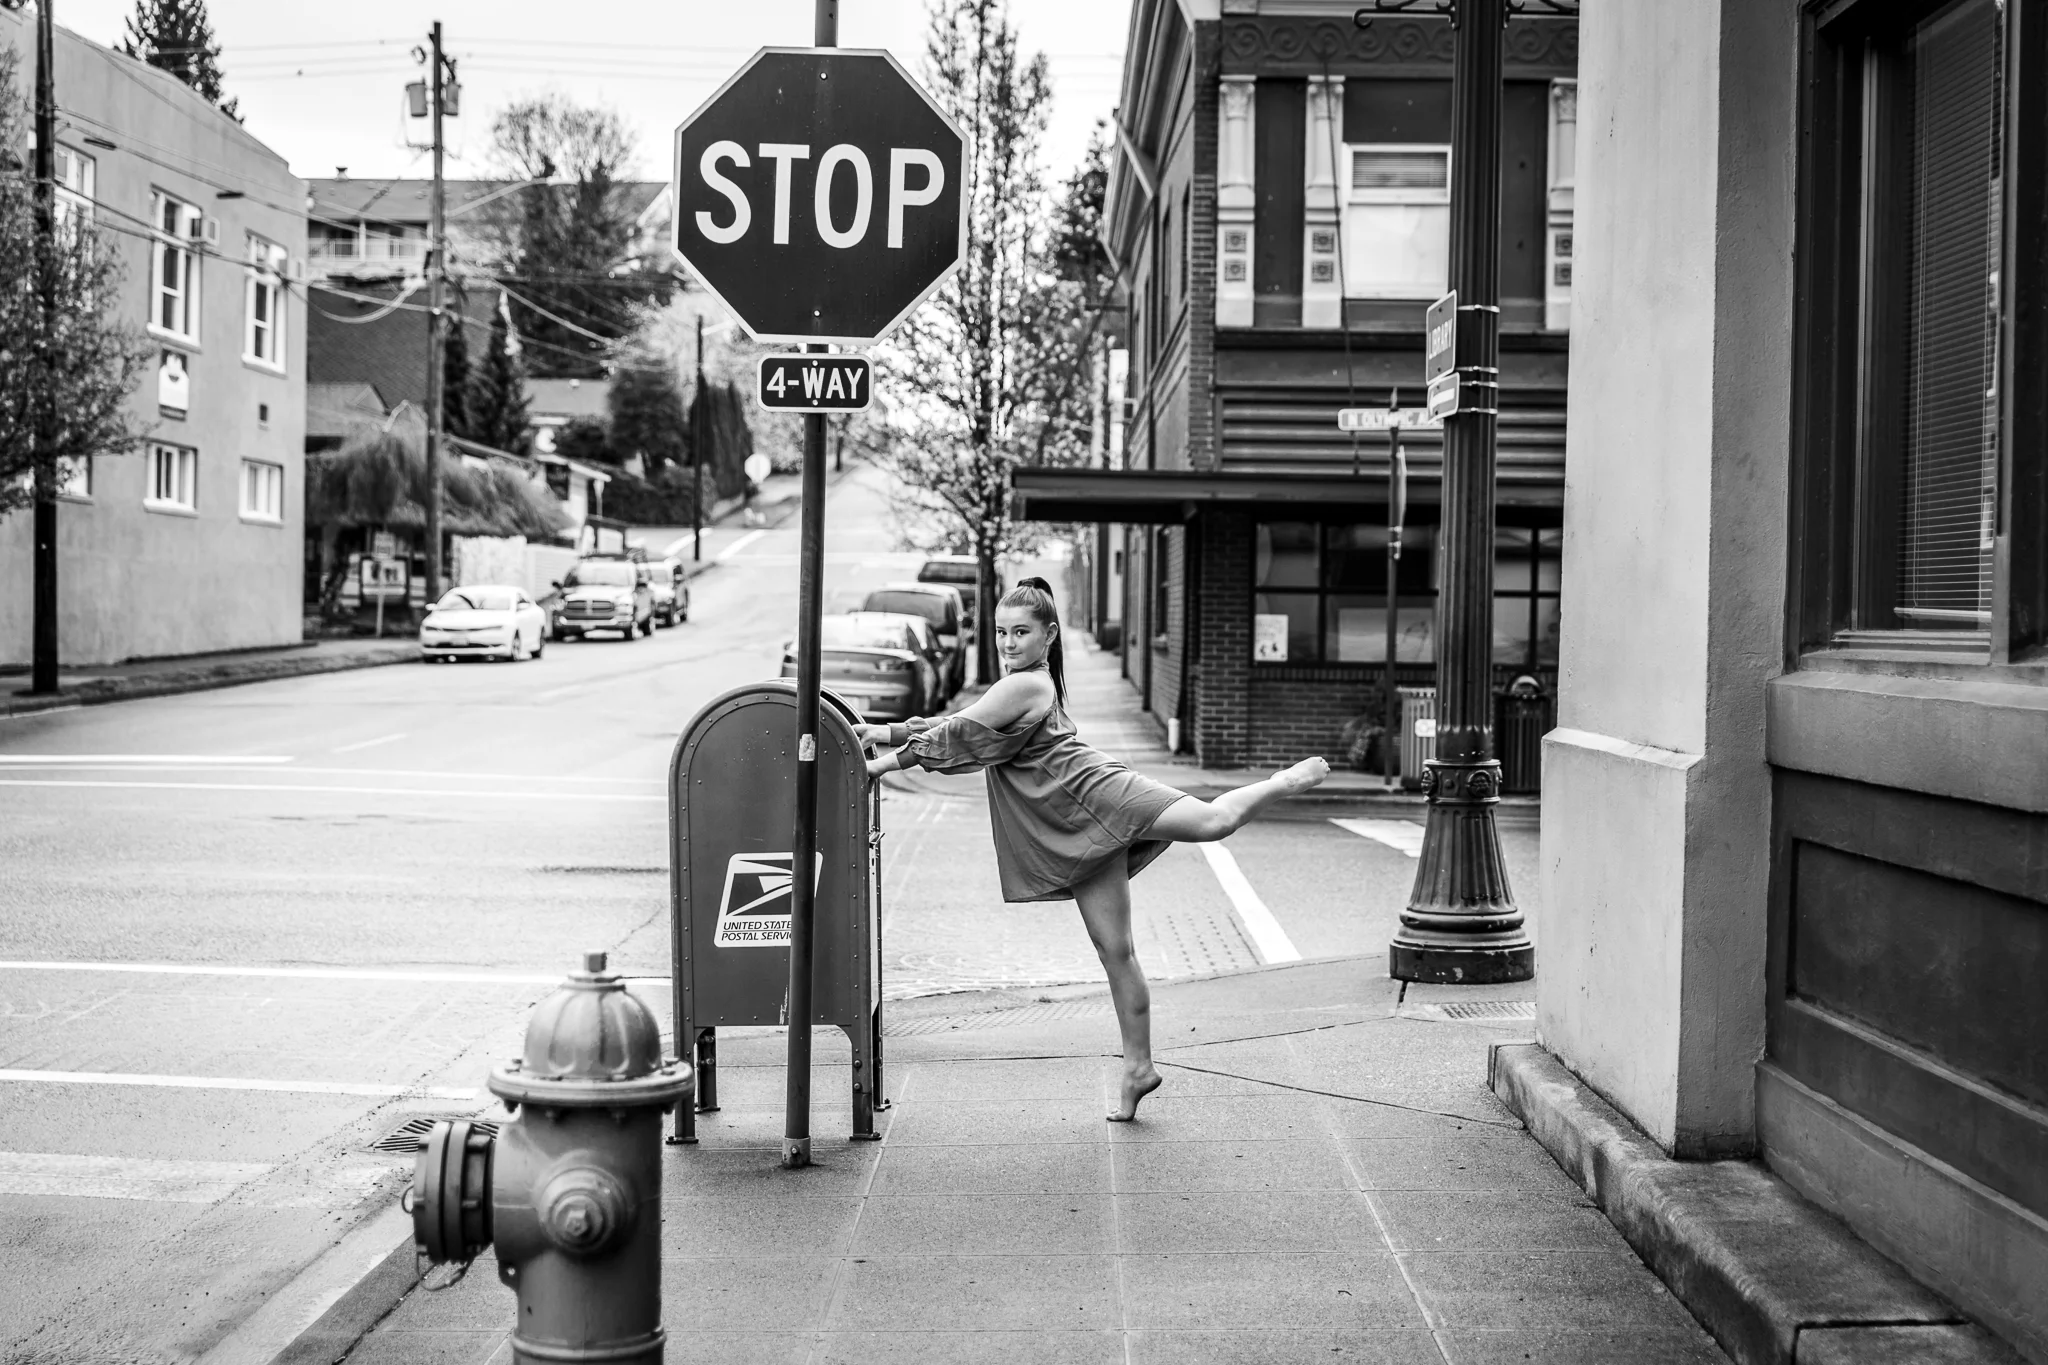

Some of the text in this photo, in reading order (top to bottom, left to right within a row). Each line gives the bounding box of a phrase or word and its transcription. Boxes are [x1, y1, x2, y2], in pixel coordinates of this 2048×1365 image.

[695, 140, 945, 249] STOP
[1429, 318, 1453, 360] LIBRARY
[766, 367, 864, 400] 4-WAY
[722, 932, 791, 941] POSTAL SERVI
[723, 921, 791, 930] UNITED STATE
